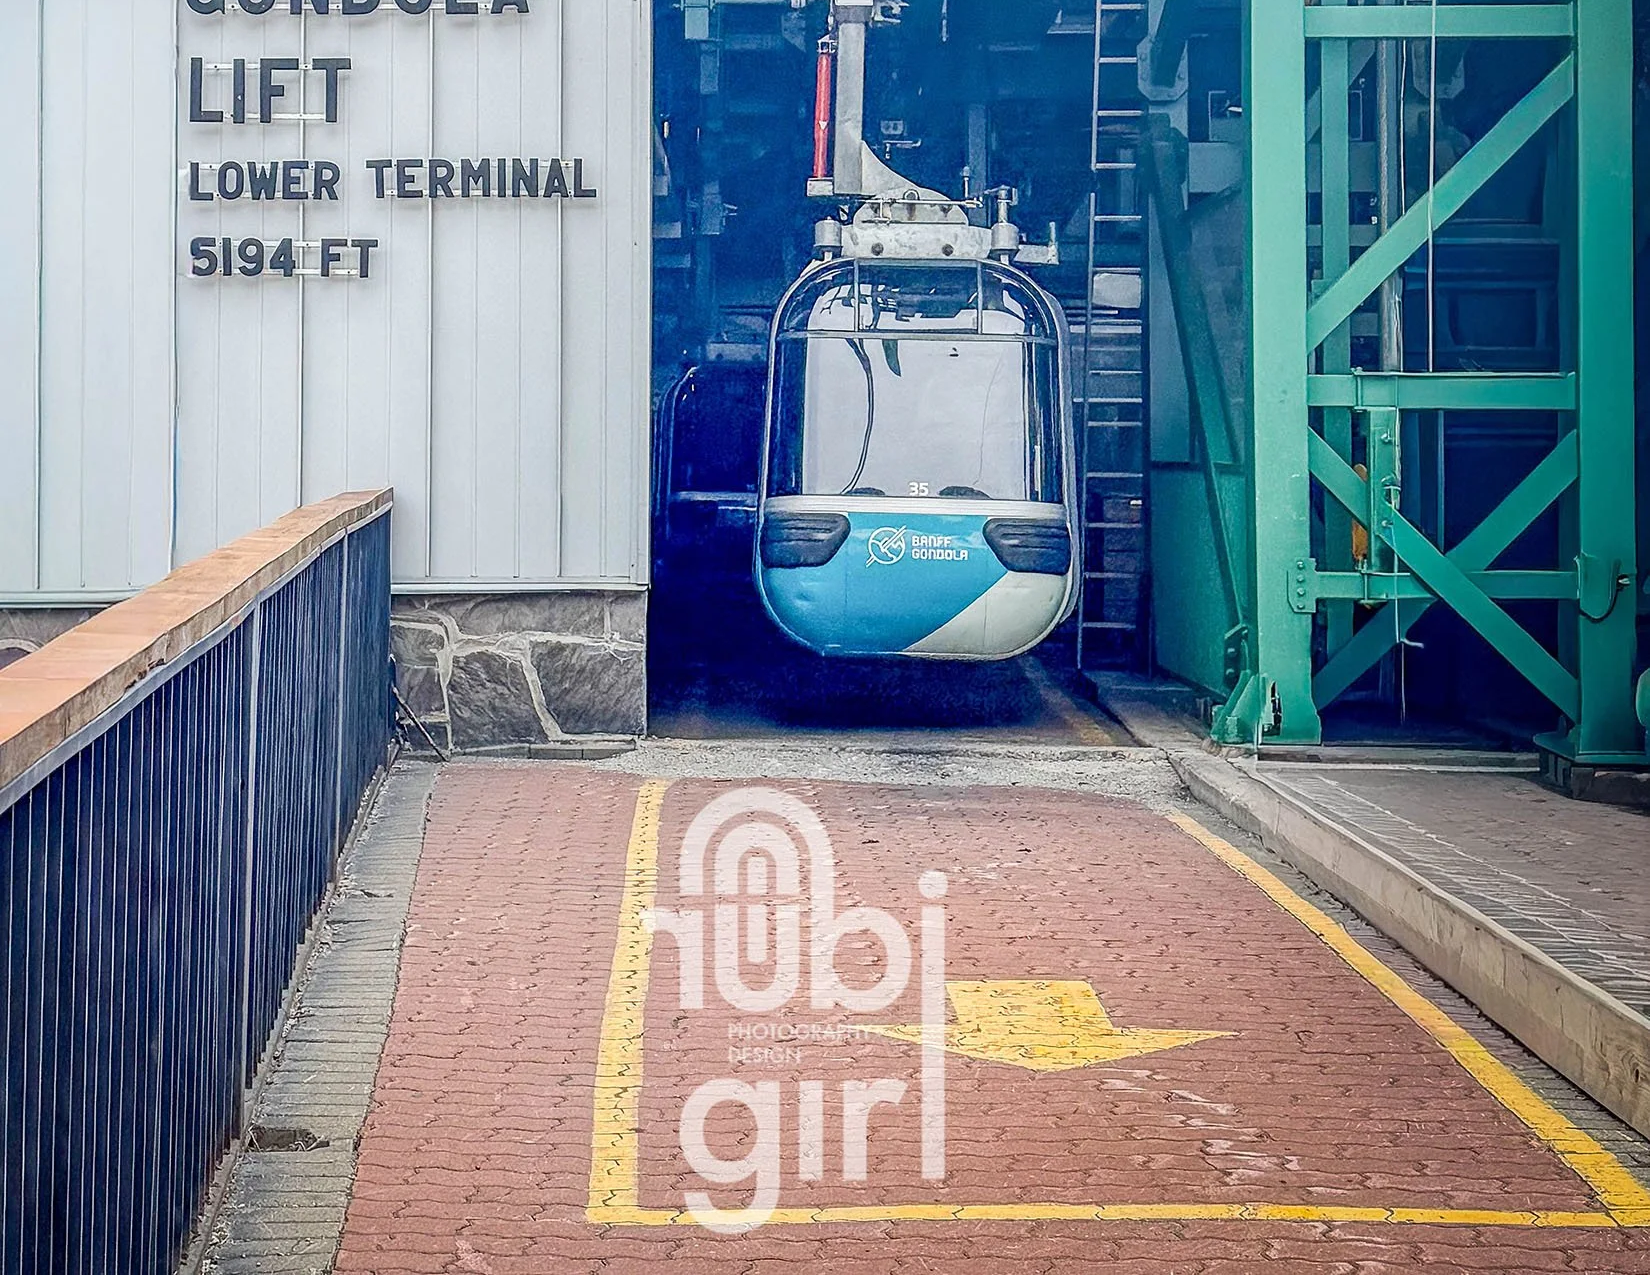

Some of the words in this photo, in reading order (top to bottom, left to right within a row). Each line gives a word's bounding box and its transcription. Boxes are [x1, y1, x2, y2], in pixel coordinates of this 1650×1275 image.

[190, 57, 351, 123] LIFT
[189, 160, 340, 200] LOWER
[366, 158, 596, 198] TERMINAL
[190, 237, 295, 277] 5194
[321, 238, 378, 278] FT
[908, 482, 928, 496] 35
[912, 536, 951, 547] BANFF
[912, 549, 969, 560] GONDOLA
